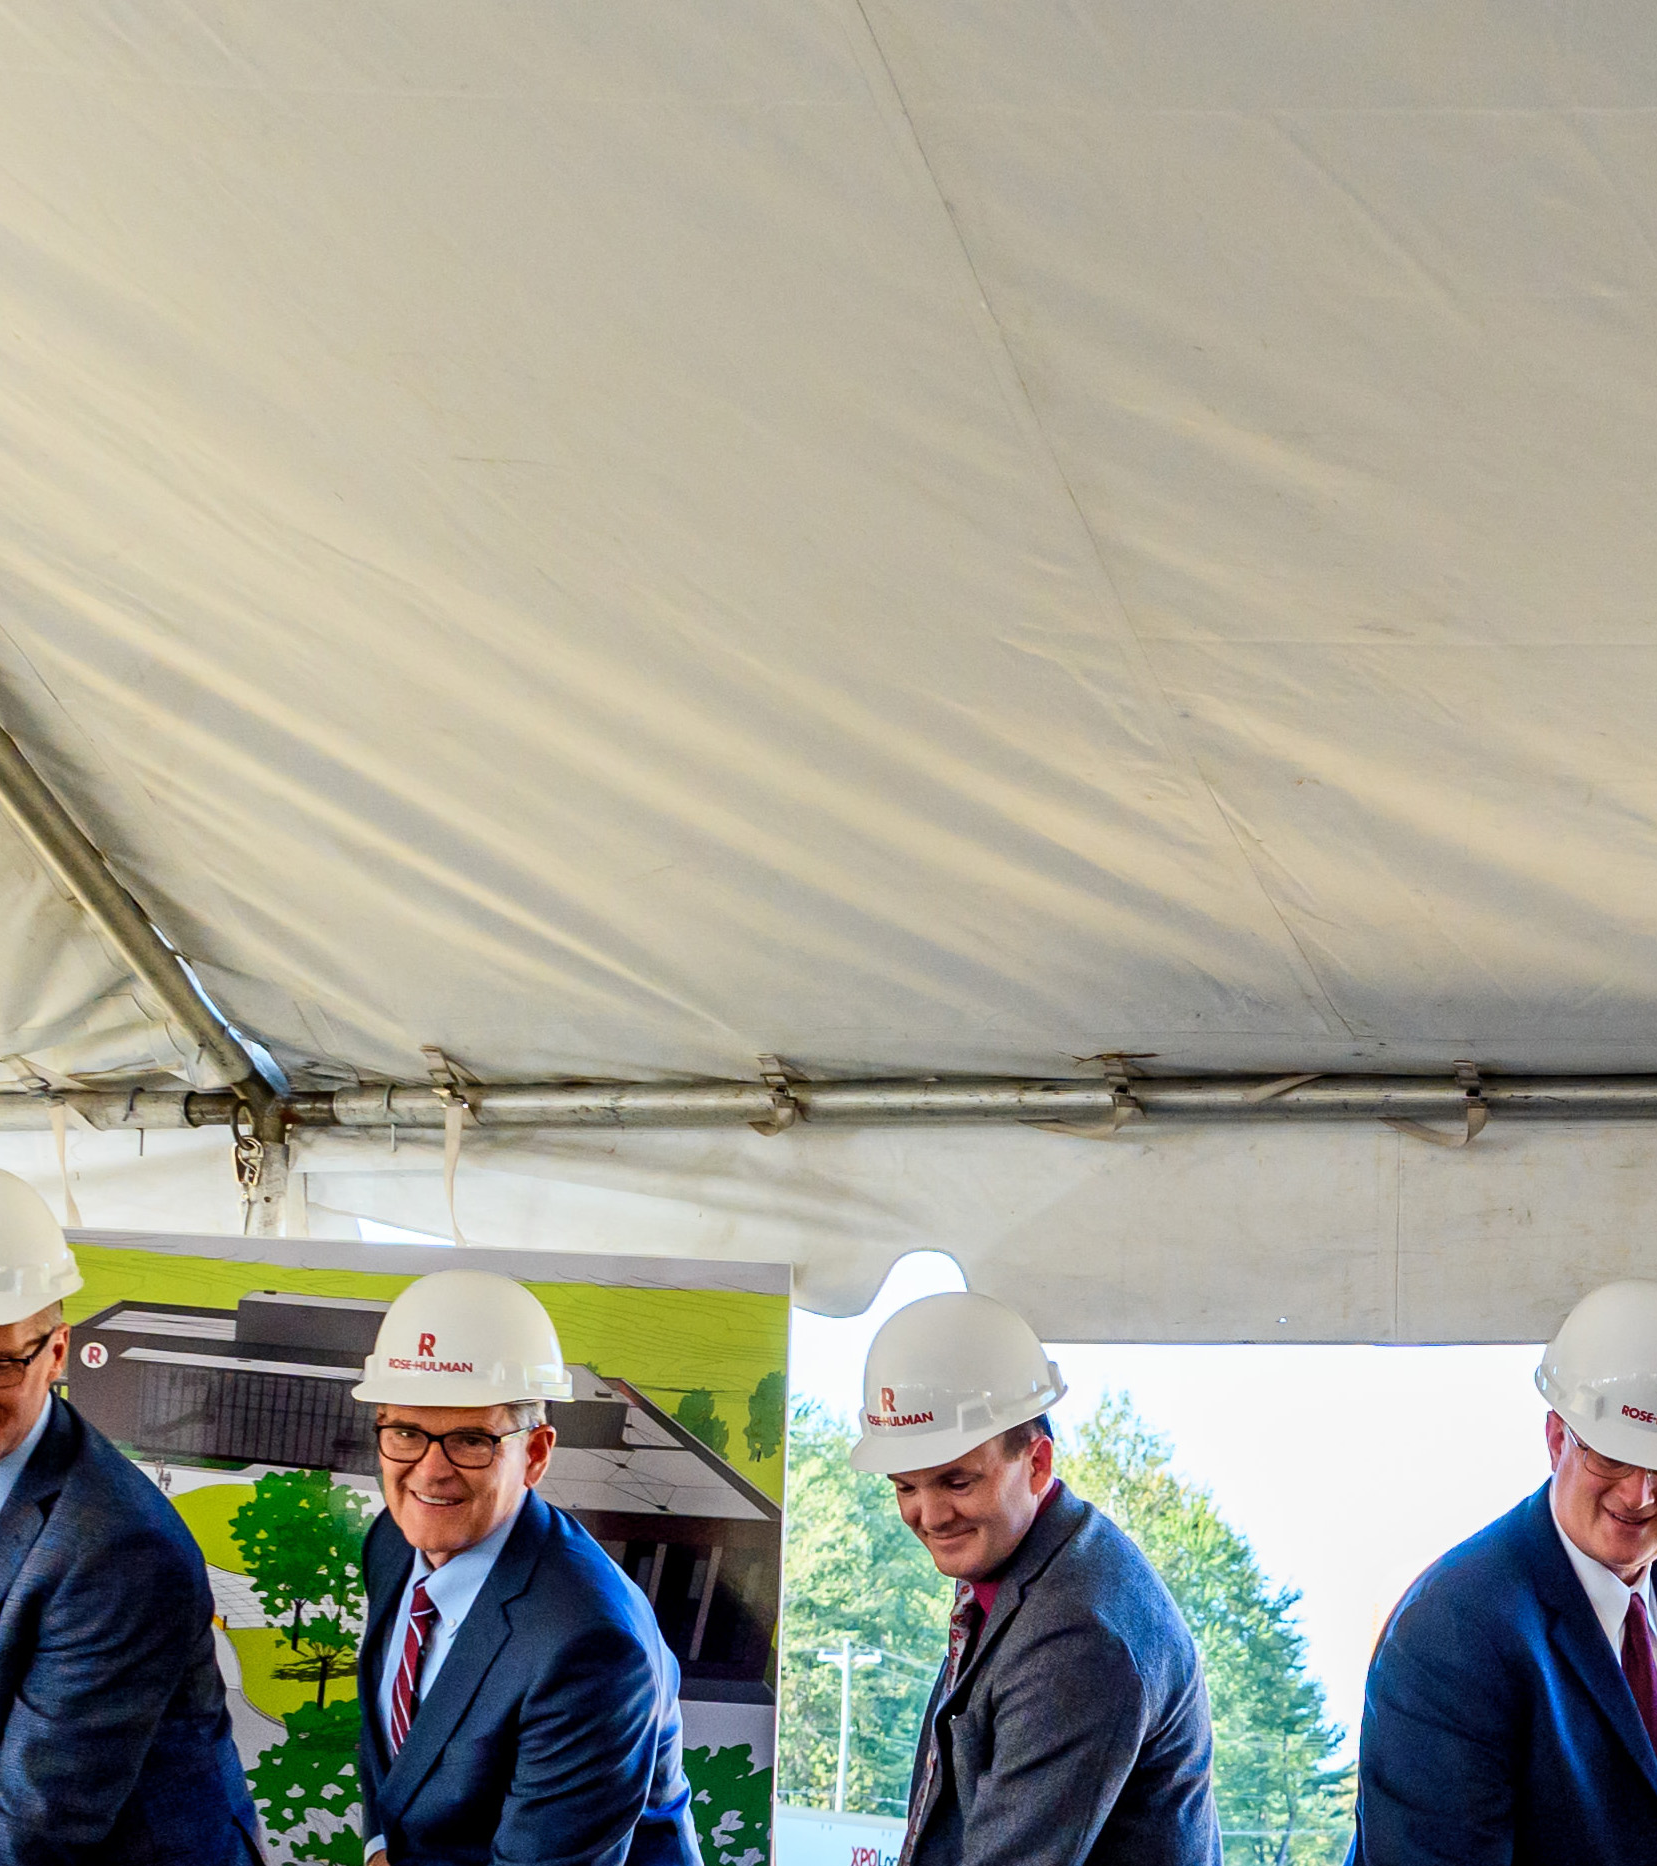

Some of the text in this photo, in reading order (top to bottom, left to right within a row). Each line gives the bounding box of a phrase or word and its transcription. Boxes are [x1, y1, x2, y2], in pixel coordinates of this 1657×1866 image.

[418, 1333, 436, 1357] R
[388, 1358, 473, 1373] ROSE-HULMAN
[881, 1387, 896, 1412] R
[867, 1411, 934, 1427] OSE-HULMAN
